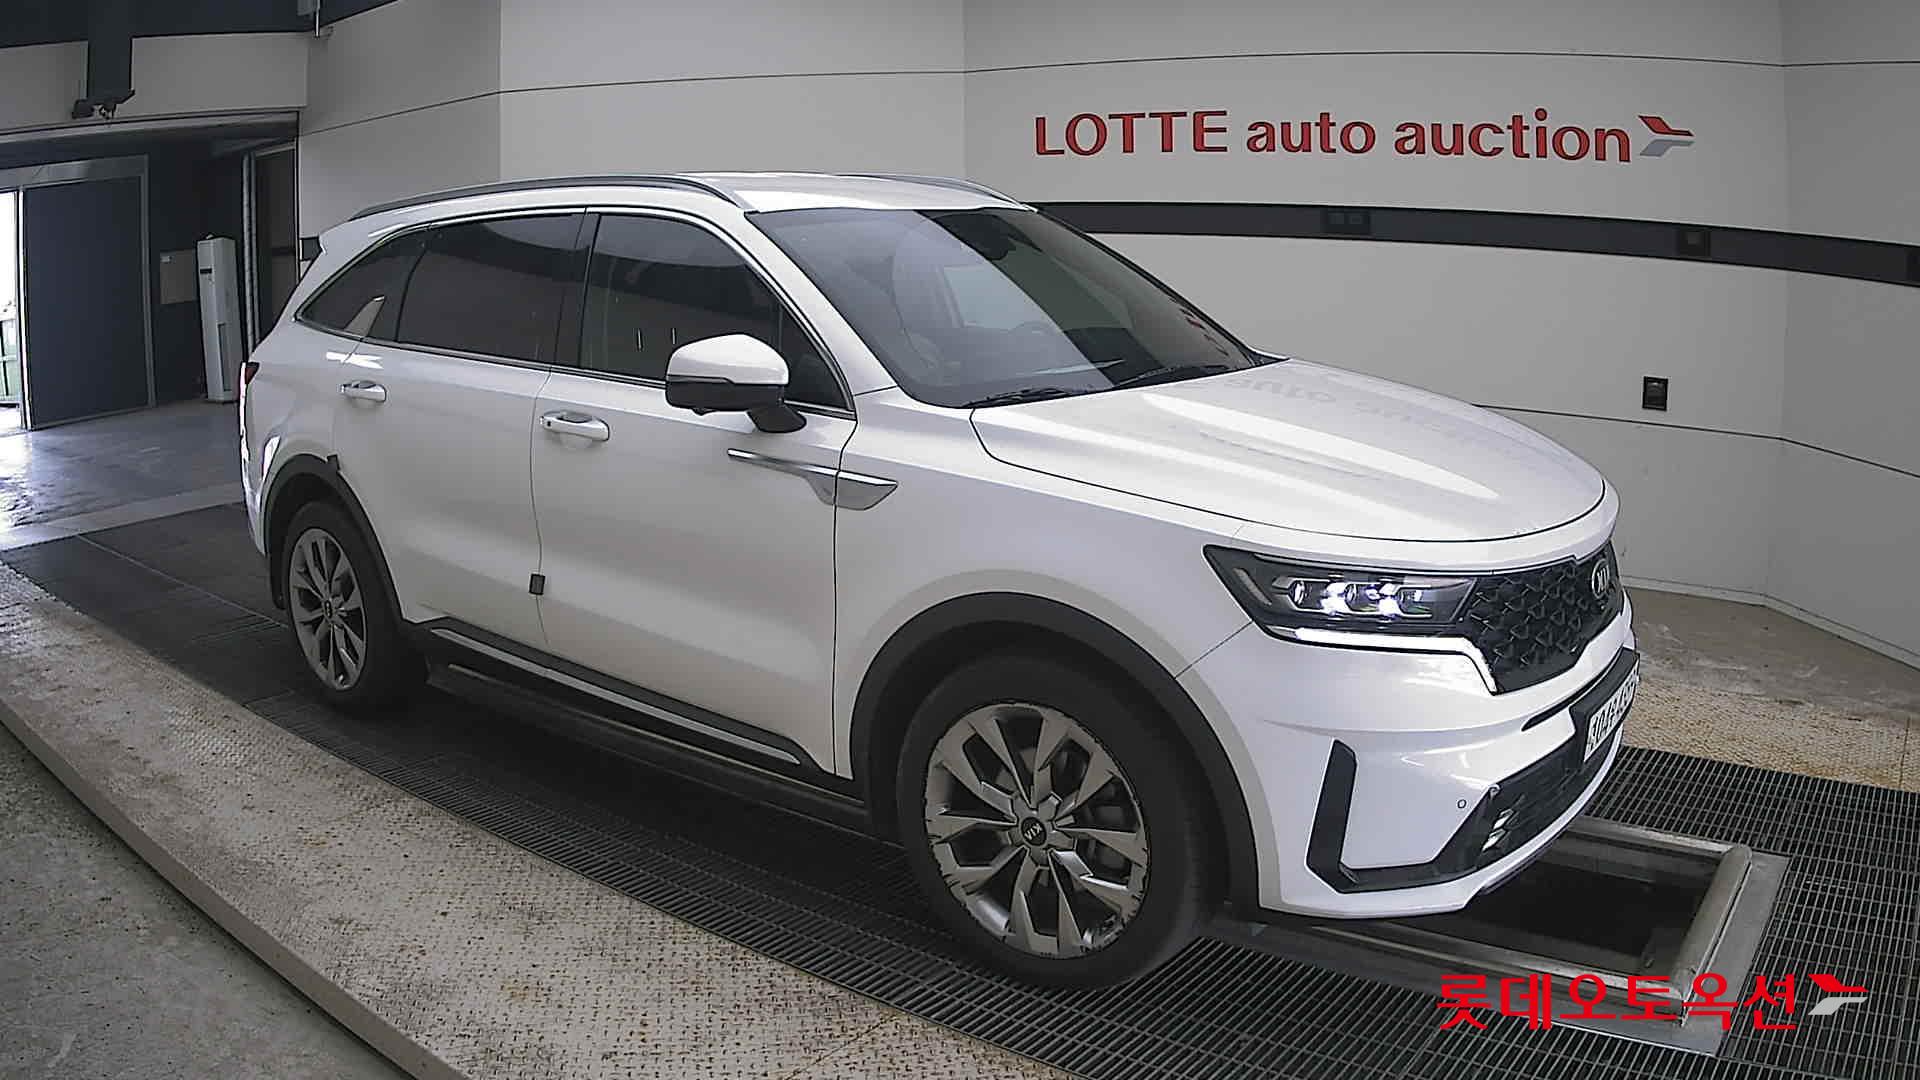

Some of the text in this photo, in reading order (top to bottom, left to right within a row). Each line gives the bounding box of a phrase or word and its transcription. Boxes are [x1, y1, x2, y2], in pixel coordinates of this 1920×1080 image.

[1035, 108, 1632, 163] LOTTE auto auction
[1024, 822, 1043, 841] KIA
